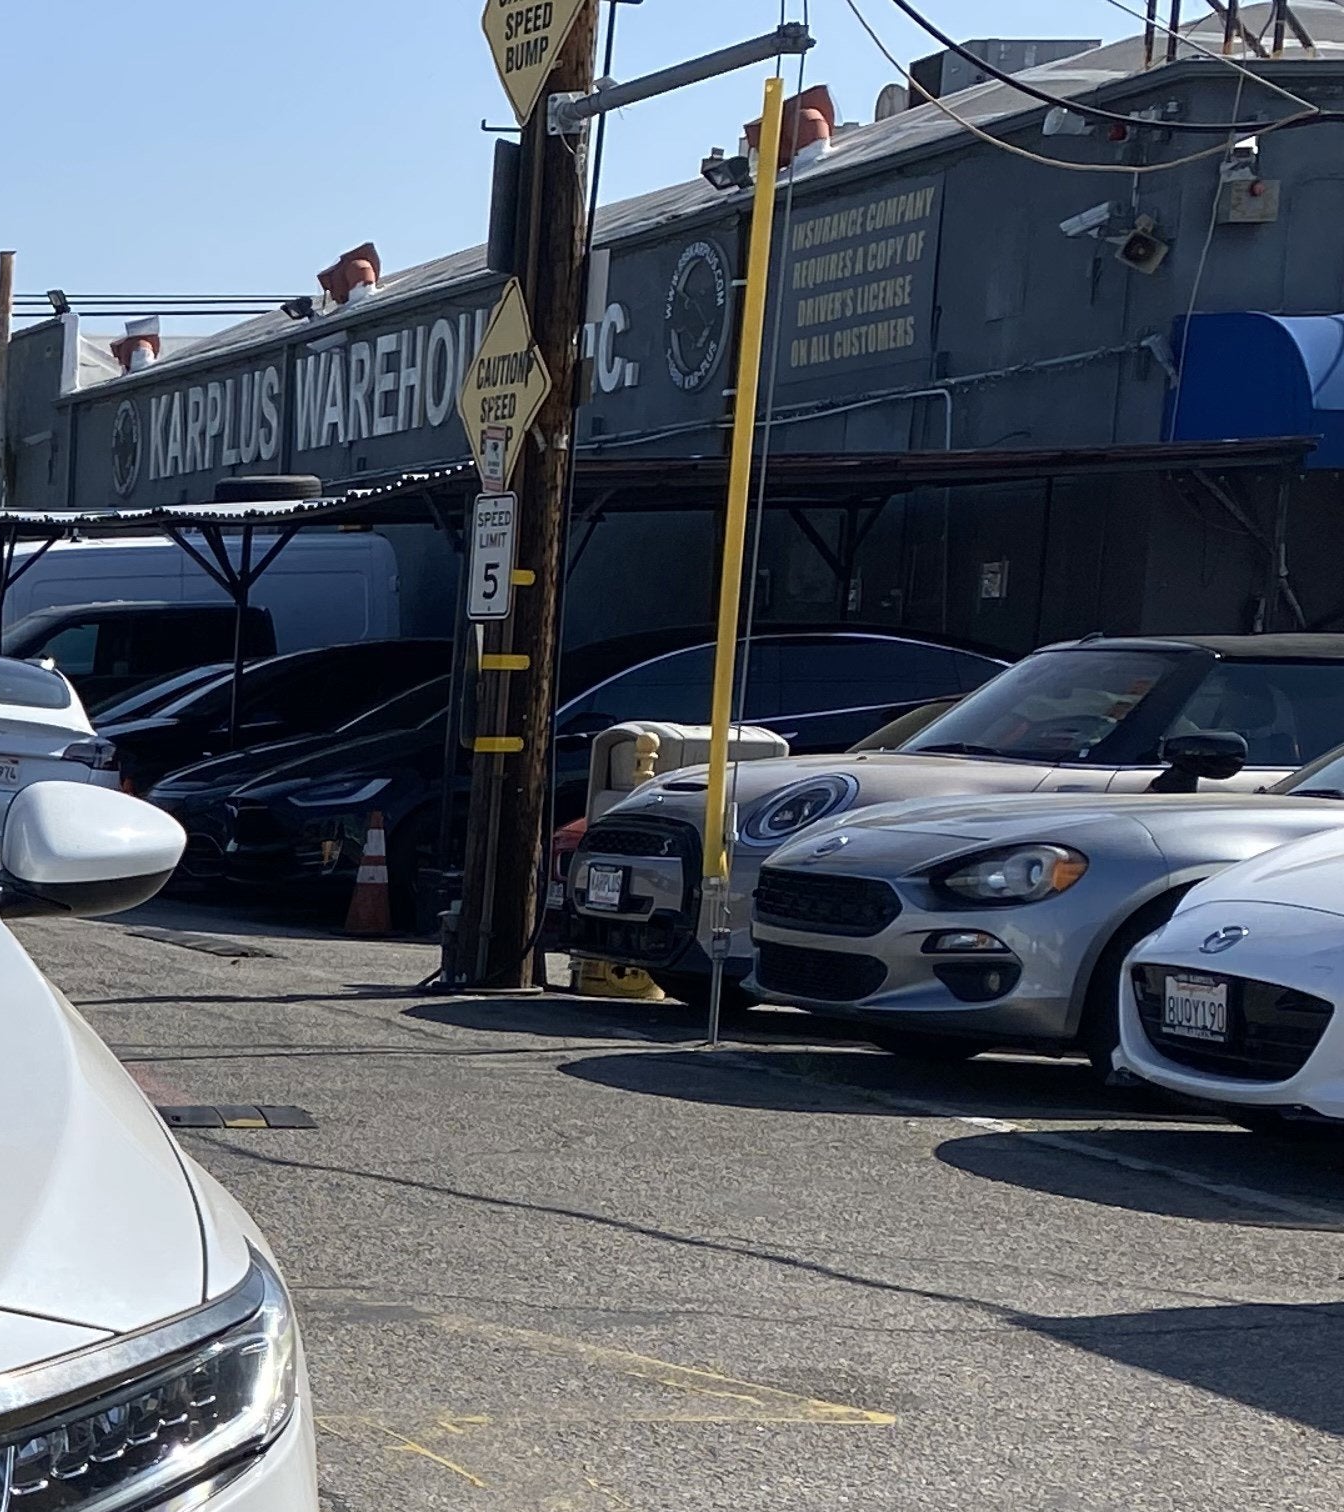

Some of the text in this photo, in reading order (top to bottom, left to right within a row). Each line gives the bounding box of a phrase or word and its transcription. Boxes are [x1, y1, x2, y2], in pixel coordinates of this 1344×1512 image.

[505, 2, 553, 41] SPEED
[505, 36, 549, 74] BUMP
[792, 187, 935, 251] INSURANCE COMPANY
[792, 230, 926, 290] REQUIRES A COPY OF
[797, 274, 913, 328] DRIVER'S LICENSE
[810, 333, 831, 364] ALL
[833, 315, 915, 359] CUSTOMERS
[149, 366, 280, 480] KARPLUS
[296, 309, 489, 451] WAREHOU
[480, 392, 516, 423] SPEED
[477, 510, 512, 528] SPEED
[479, 532, 507, 549] LIMIT
[482, 562, 500, 600] 5
